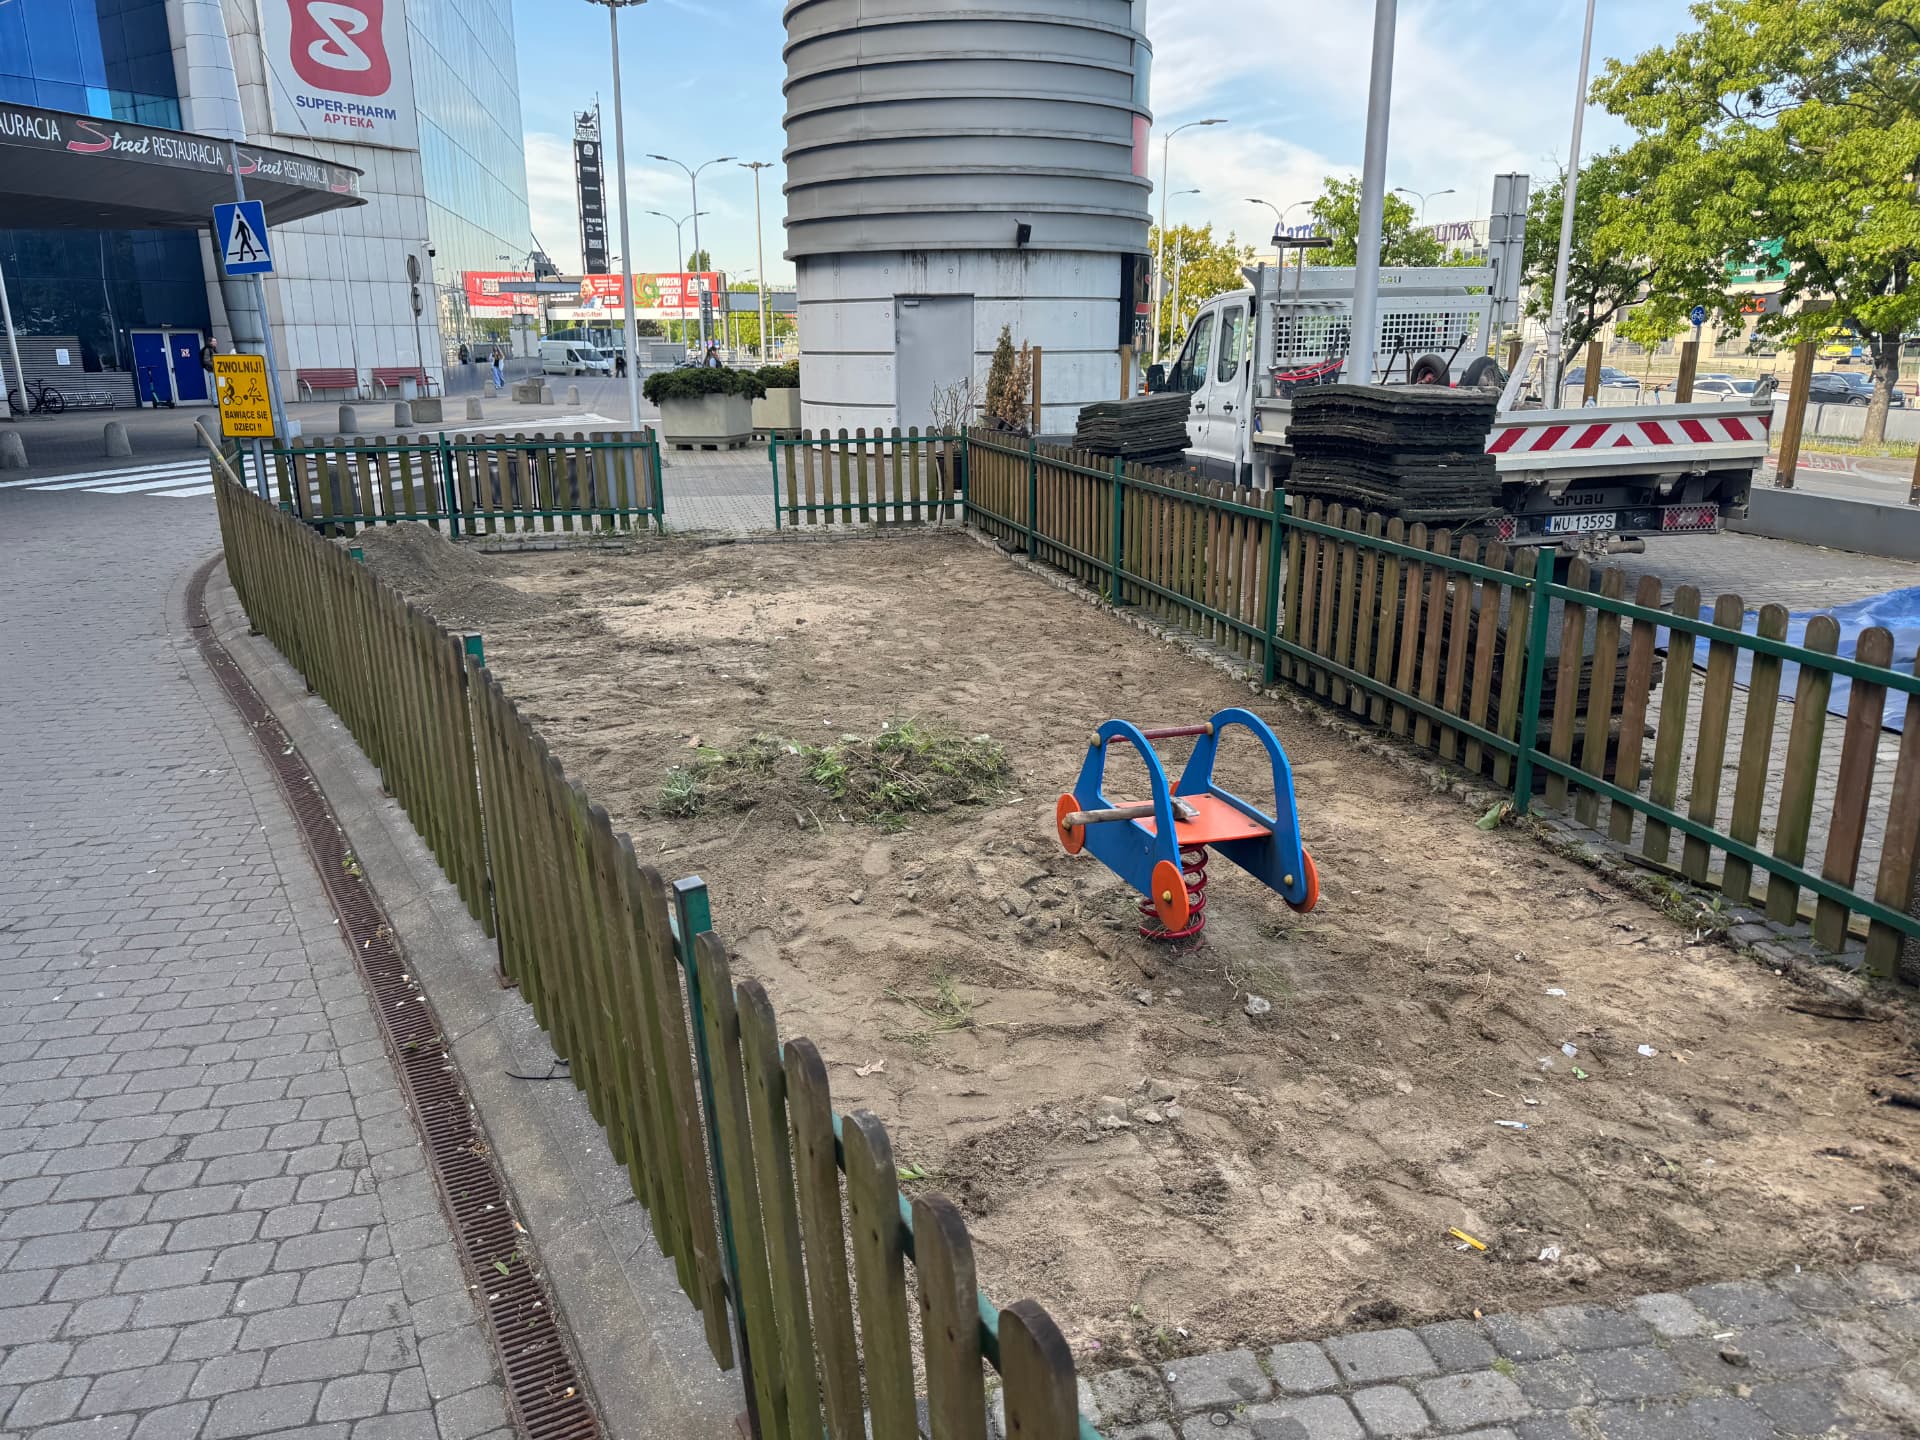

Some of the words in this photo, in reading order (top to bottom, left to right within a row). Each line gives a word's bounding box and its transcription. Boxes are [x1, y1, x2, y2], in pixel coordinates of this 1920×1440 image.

[295, 95, 397, 121] SUPER-PHARM
[323, 112, 375, 129] APTEKA
[66, 120, 151, 153] Street
[152, 136, 224, 167] RESTAURACJA
[283, 160, 329, 185] RESTAURACJA
[216, 361, 262, 374] ZWOLNIJ!
[224, 410, 255, 421] BAWIĄCE
[256, 410, 268, 420] SIĘ
[234, 422, 256, 432] DZIECI
[1553, 516, 1571, 531] WU
[1575, 514, 1613, 530] 1359S
